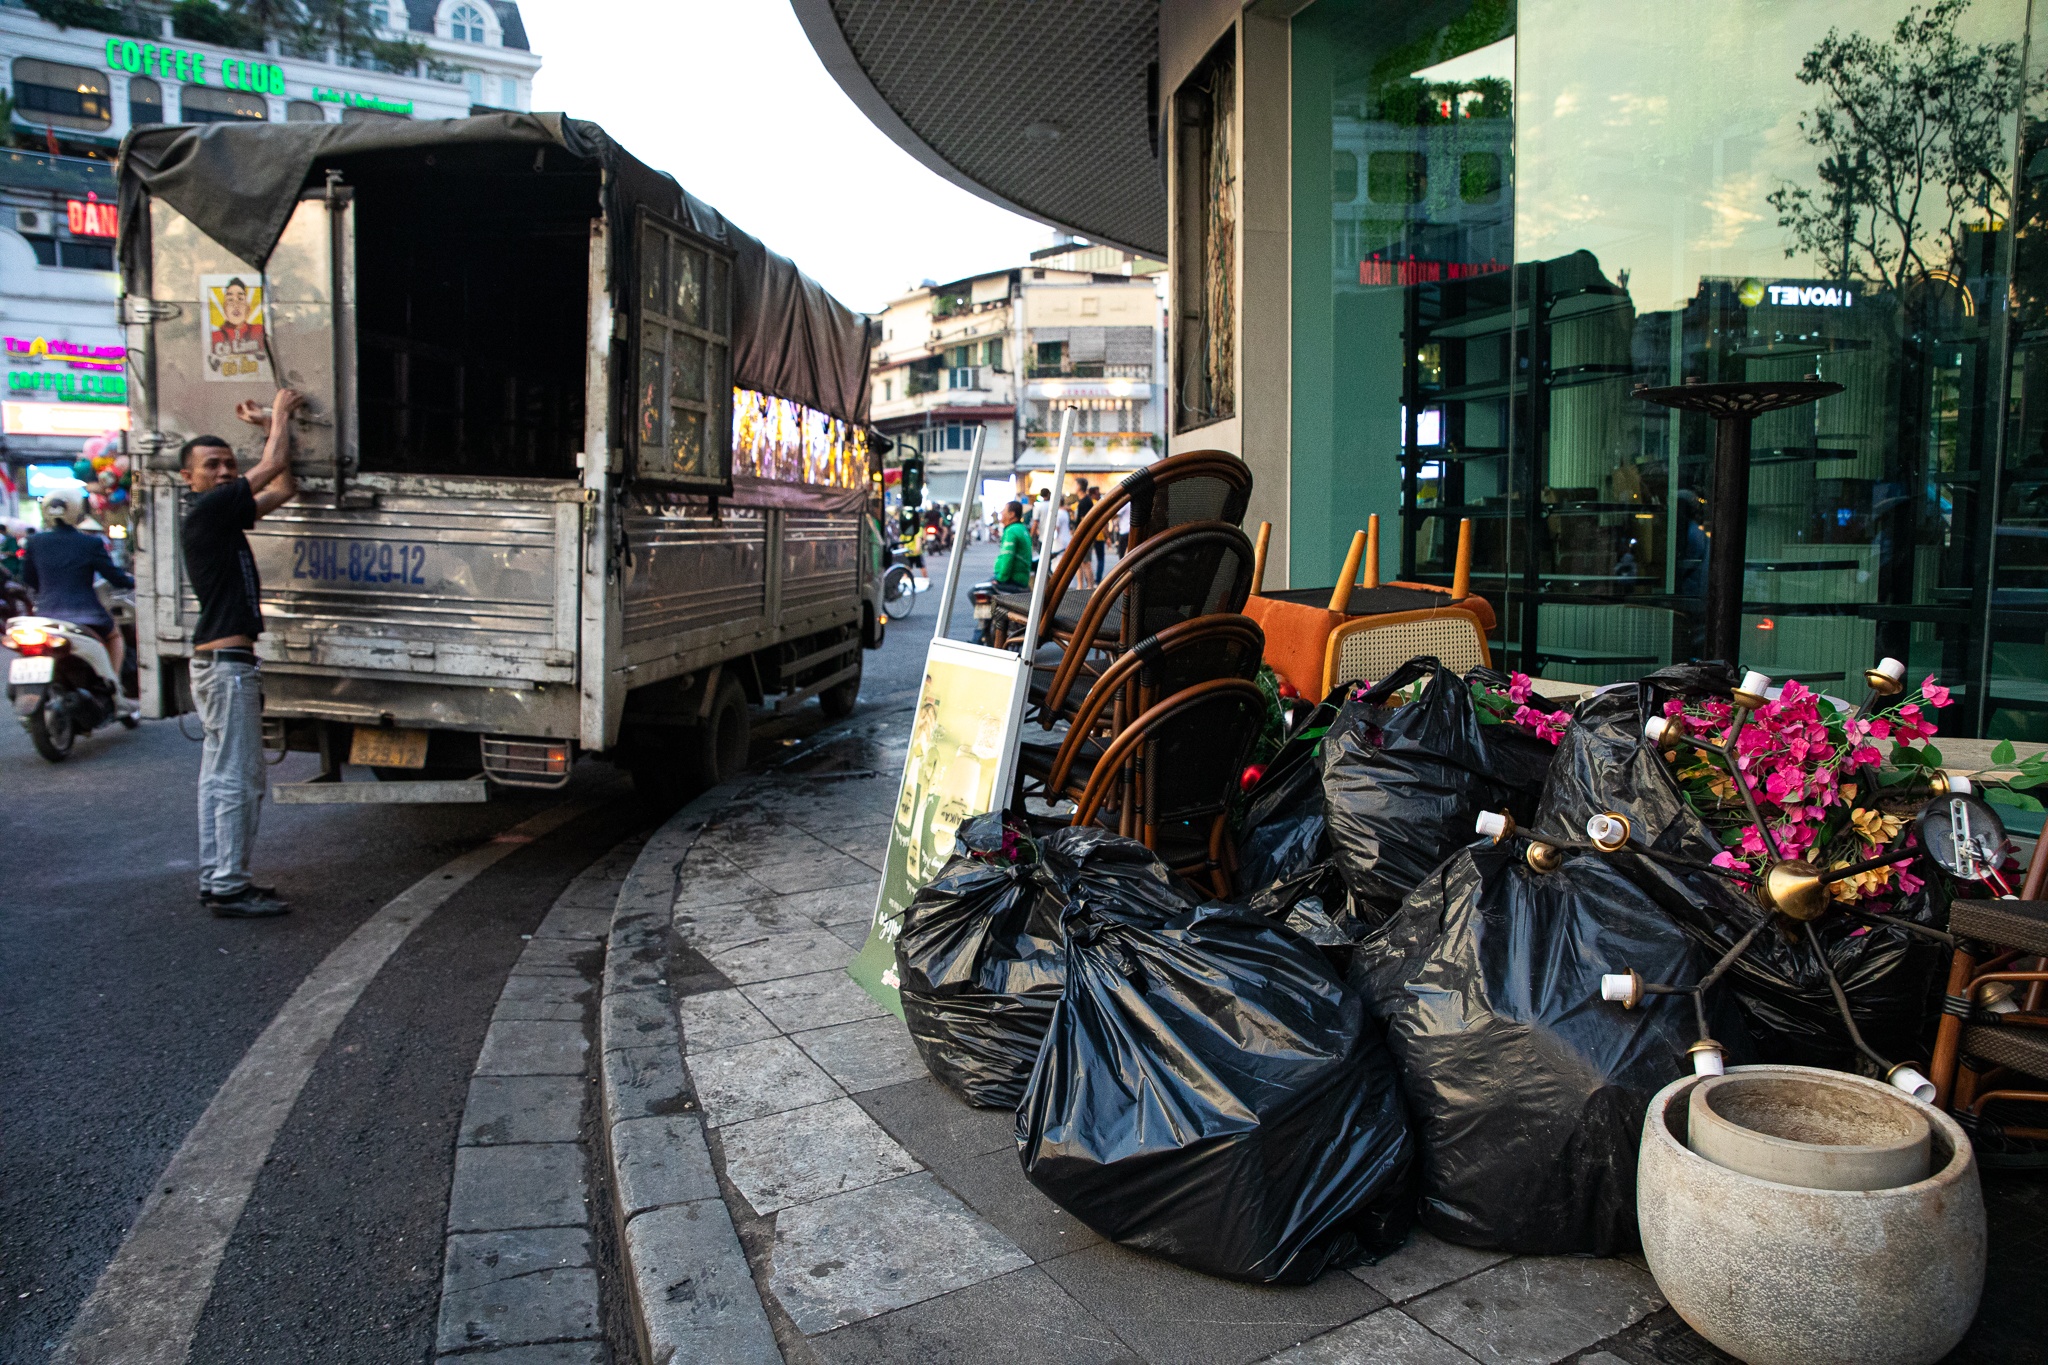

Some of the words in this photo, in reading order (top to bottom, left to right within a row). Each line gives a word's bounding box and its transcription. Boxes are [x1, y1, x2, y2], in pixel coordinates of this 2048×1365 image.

[106, 38, 206, 85] COFFEE
[221, 58, 285, 95] CLUB
[8, 371, 76, 392] COFFEE
